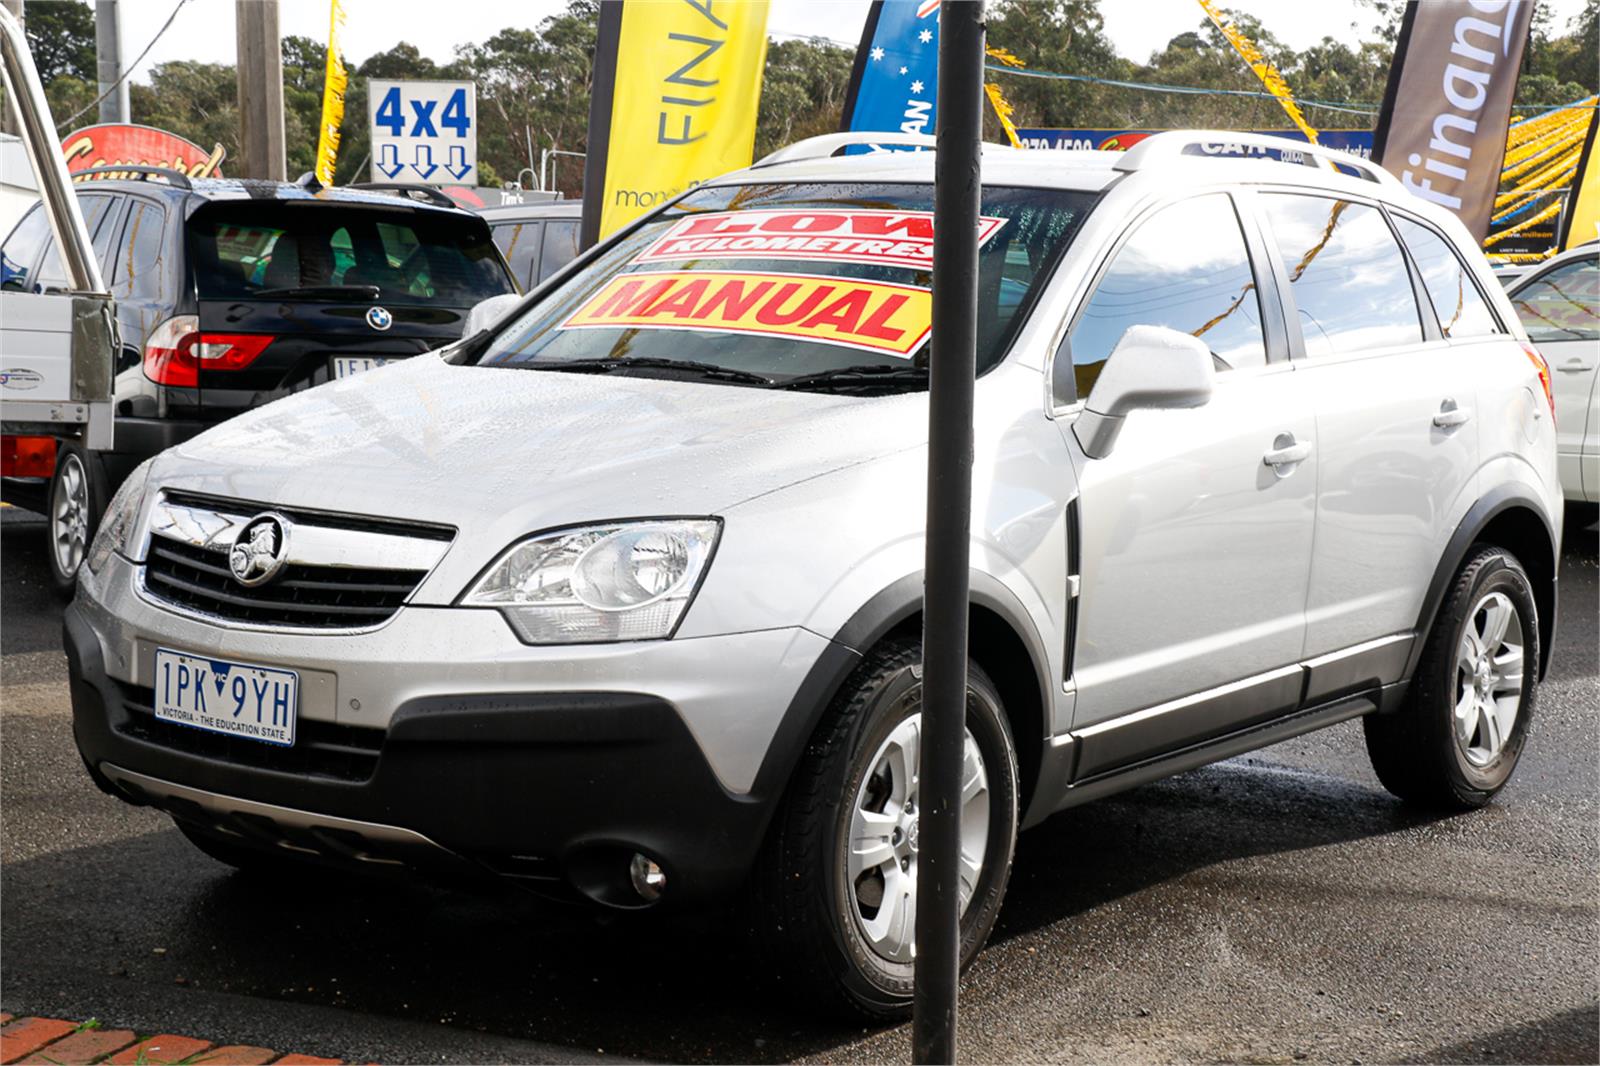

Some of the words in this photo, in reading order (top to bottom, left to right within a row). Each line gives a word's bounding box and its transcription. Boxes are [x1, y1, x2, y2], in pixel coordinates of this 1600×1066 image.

[375, 86, 471, 138] 4x4
[678, 214, 981, 239] LOW
[589, 279, 910, 342] MANUAL
[164, 662, 207, 713] 1PK
[232, 675, 289, 727] 9YH
[162, 707, 194, 722] VICTORIA
[200, 715, 214, 727] THE
[215, 720, 259, 735] EDUCATION
[261, 727, 285, 740] STATE
